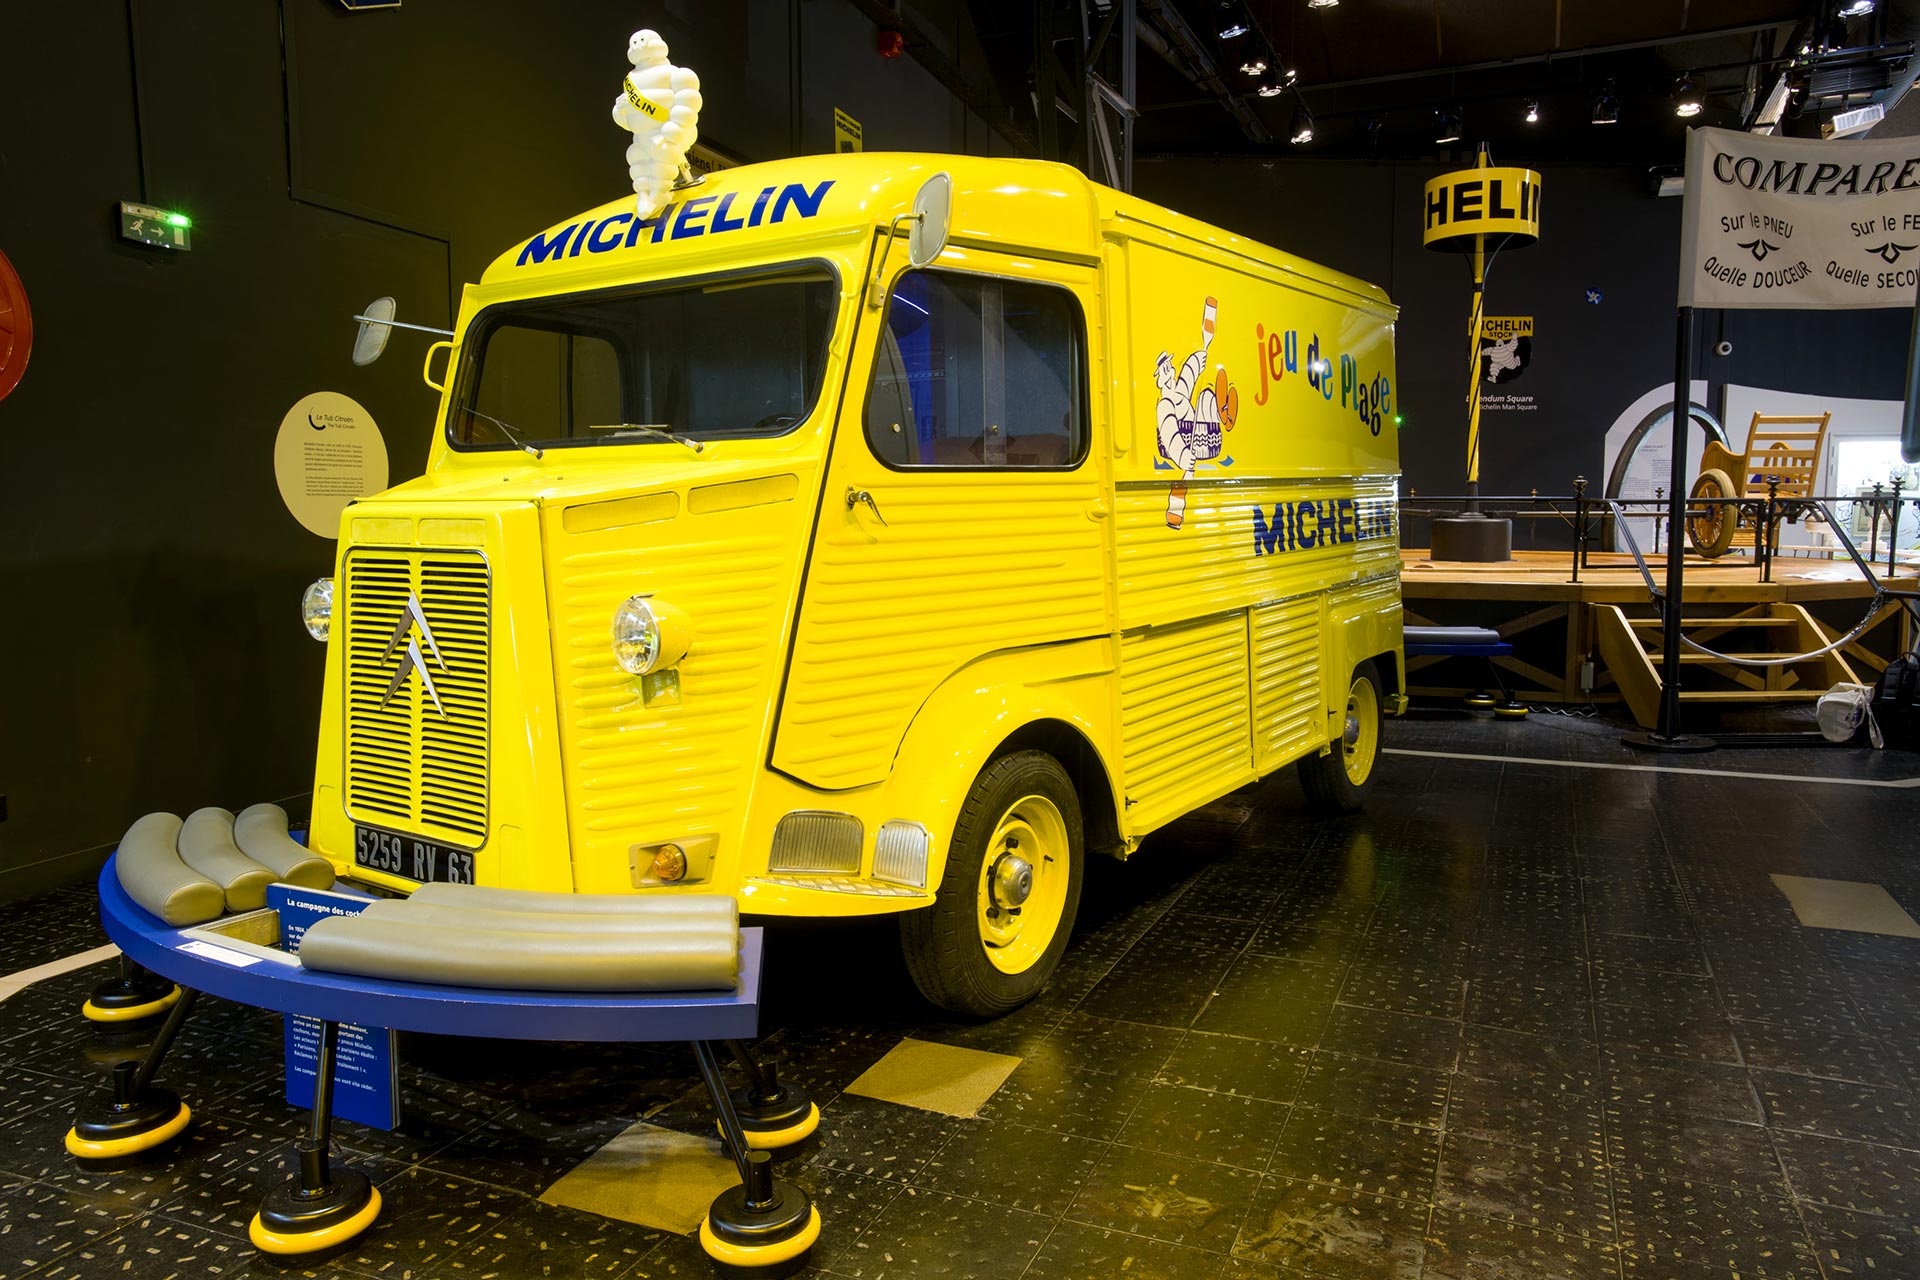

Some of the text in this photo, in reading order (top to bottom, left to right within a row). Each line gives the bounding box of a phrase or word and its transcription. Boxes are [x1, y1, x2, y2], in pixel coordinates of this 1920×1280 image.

[1713, 152, 1920, 197] COMPARE
[515, 180, 837, 267] MICHELIN
[1720, 212, 1794, 239] Sur le PNEU
[1850, 219, 1876, 238] Sur
[1882, 215, 1897, 231] le
[1703, 256, 1812, 288] Quelle DOUCEUR
[1825, 260, 1870, 288] Quelle
[1470, 320, 1531, 332] ICHELIN
[1254, 322, 1298, 407] jeu
[1307, 332, 1334, 401] de
[1506, 394, 1534, 404] Square
[1252, 499, 1392, 557] MICHELIN
[357, 828, 472, 885] 5259 RV 63
[287, 898, 295, 907] La
[296, 900, 331, 913] campagne
[332, 906, 344, 916] des
